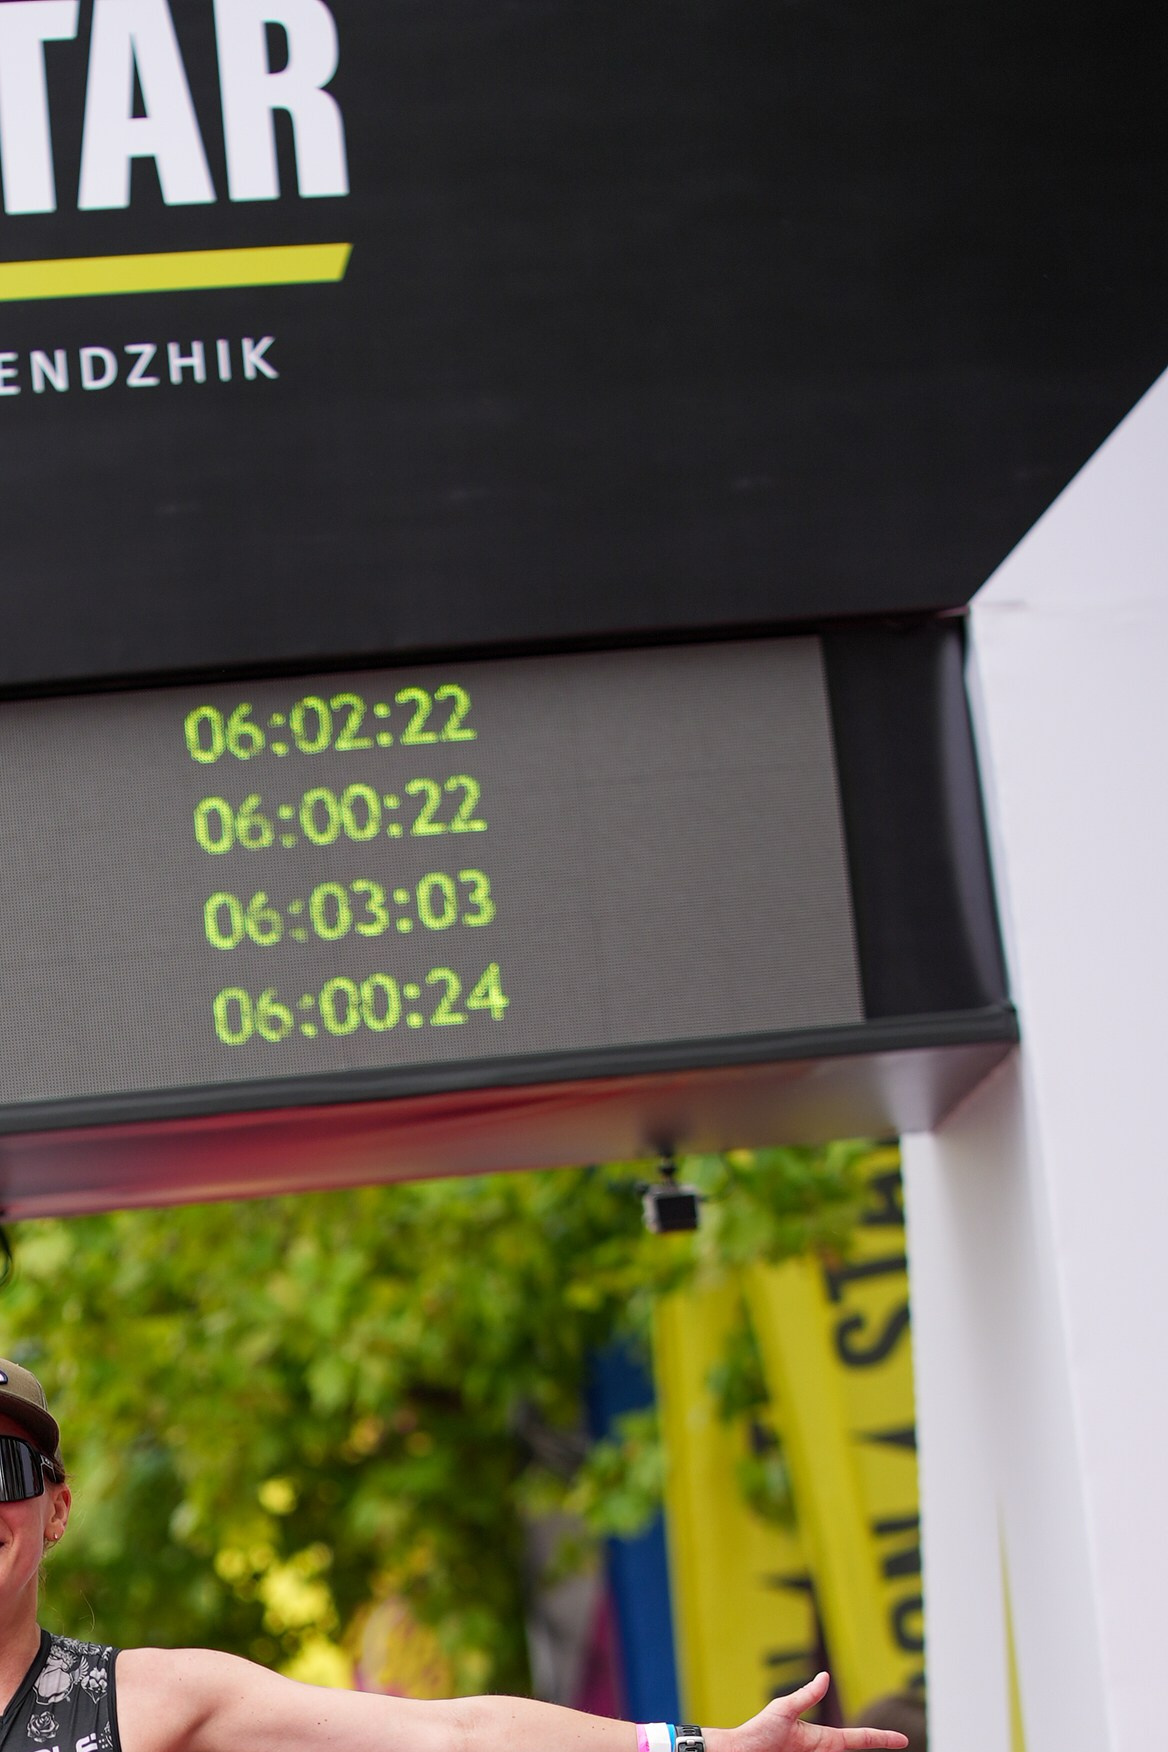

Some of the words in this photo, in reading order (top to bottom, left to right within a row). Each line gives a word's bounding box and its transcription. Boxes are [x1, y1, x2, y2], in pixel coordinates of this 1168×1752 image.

[184, 684, 478, 763] 06:02:22
[193, 774, 488, 855] 06:00:22
[203, 868, 496, 950] 06:03:03
[213, 962, 510, 1046] 06:00:24
